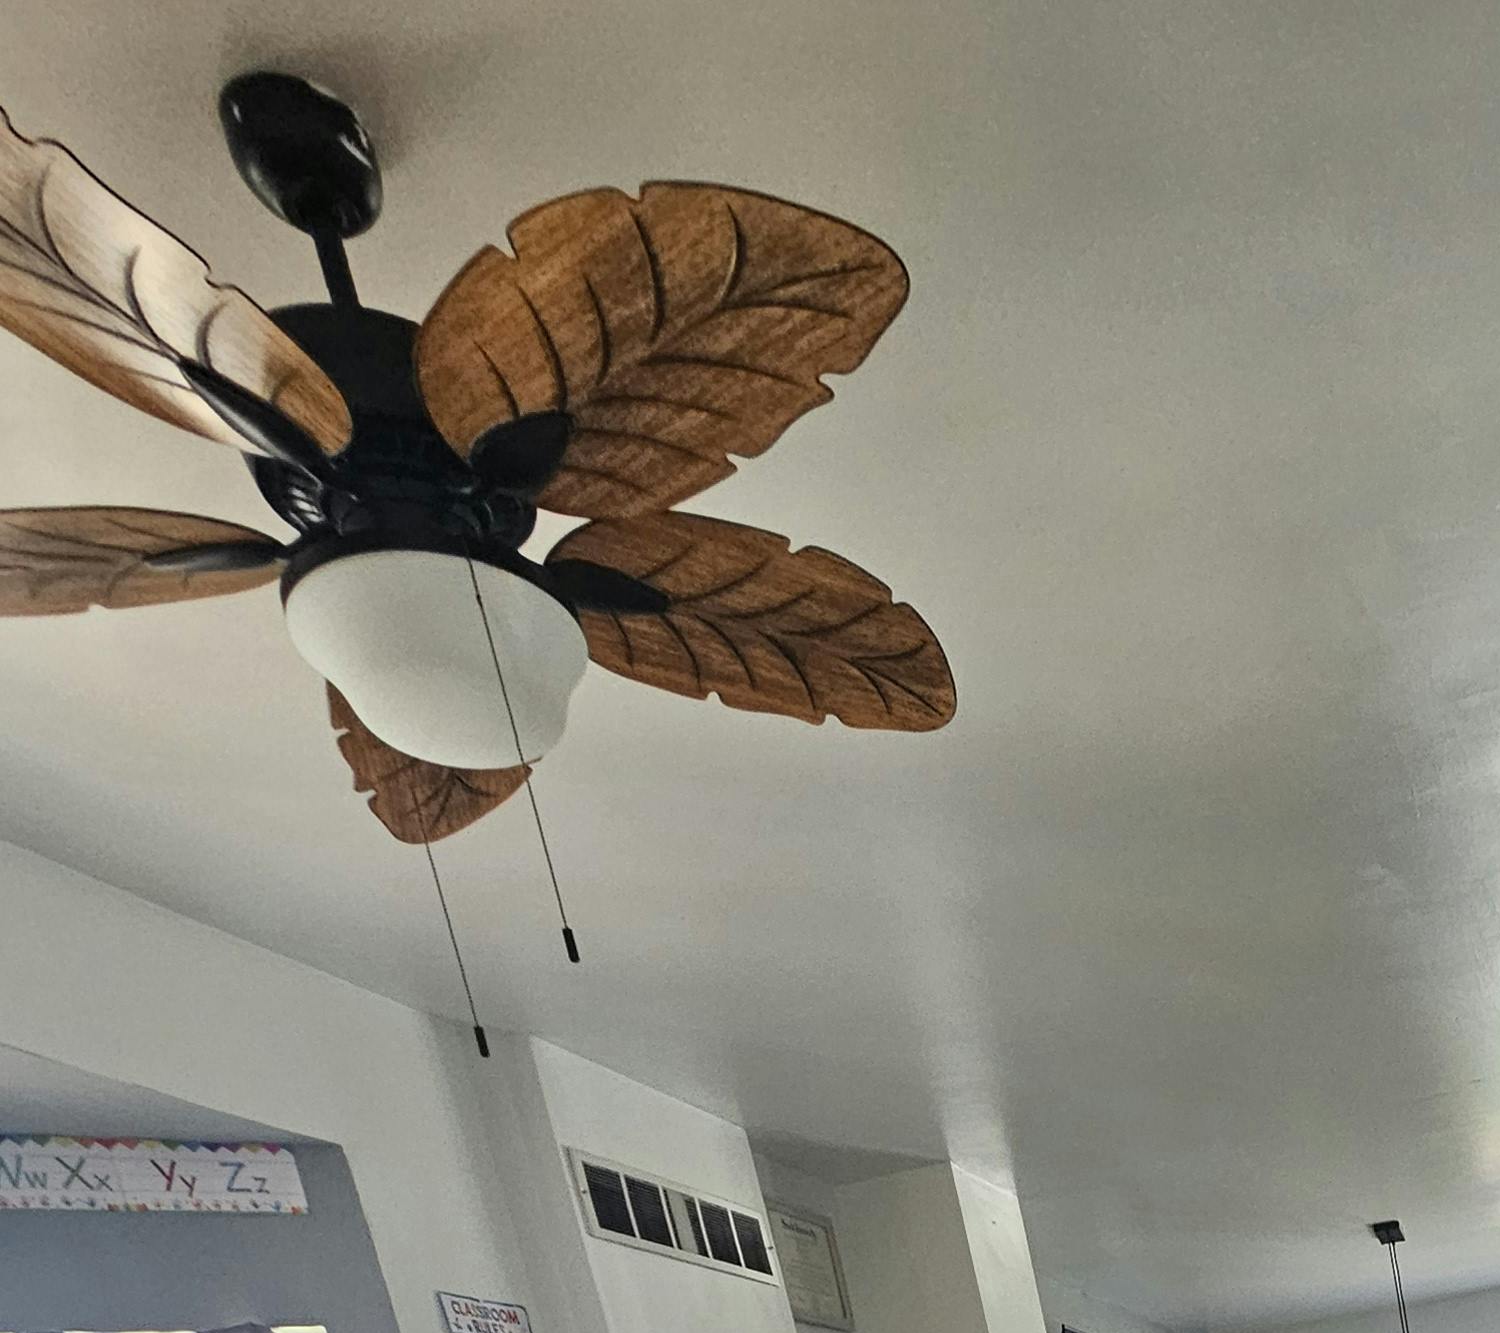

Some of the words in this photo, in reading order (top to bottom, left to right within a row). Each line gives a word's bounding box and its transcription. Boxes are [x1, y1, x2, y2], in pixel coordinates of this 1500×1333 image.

[54, 1155, 113, 1192] Xx
[150, 1159, 196, 1198] Yy
[219, 1161, 270, 1194] Zz
[450, 1300, 521, 1326] CLASSROOM
